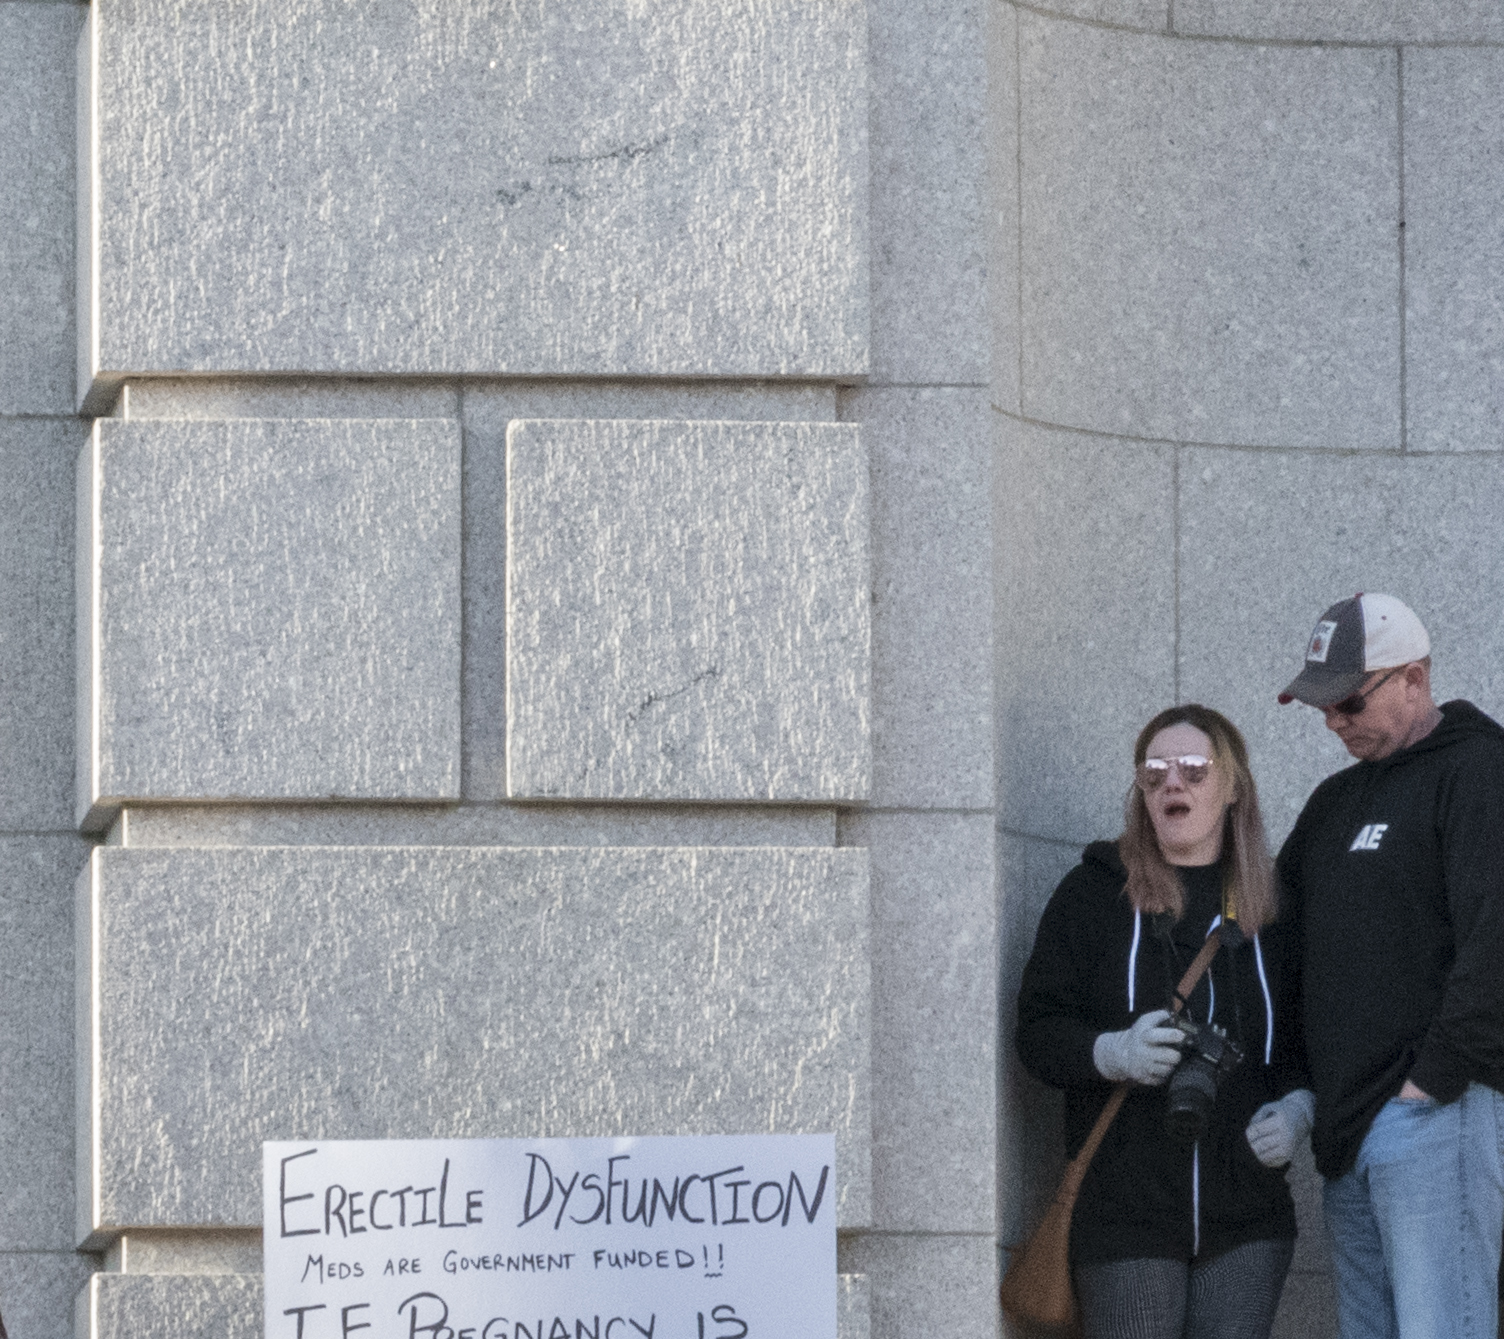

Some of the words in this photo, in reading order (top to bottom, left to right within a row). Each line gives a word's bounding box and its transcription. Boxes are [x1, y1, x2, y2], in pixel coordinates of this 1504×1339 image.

[279, 1150, 485, 1239] ERECTILE
[517, 1152, 830, 1229] DYSFUNCTION
[301, 1252, 365, 1283] MEDS
[383, 1255, 422, 1276] ARE
[442, 1249, 576, 1275] GOVERNMENT
[593, 1243, 725, 1274] FUNDED!!
